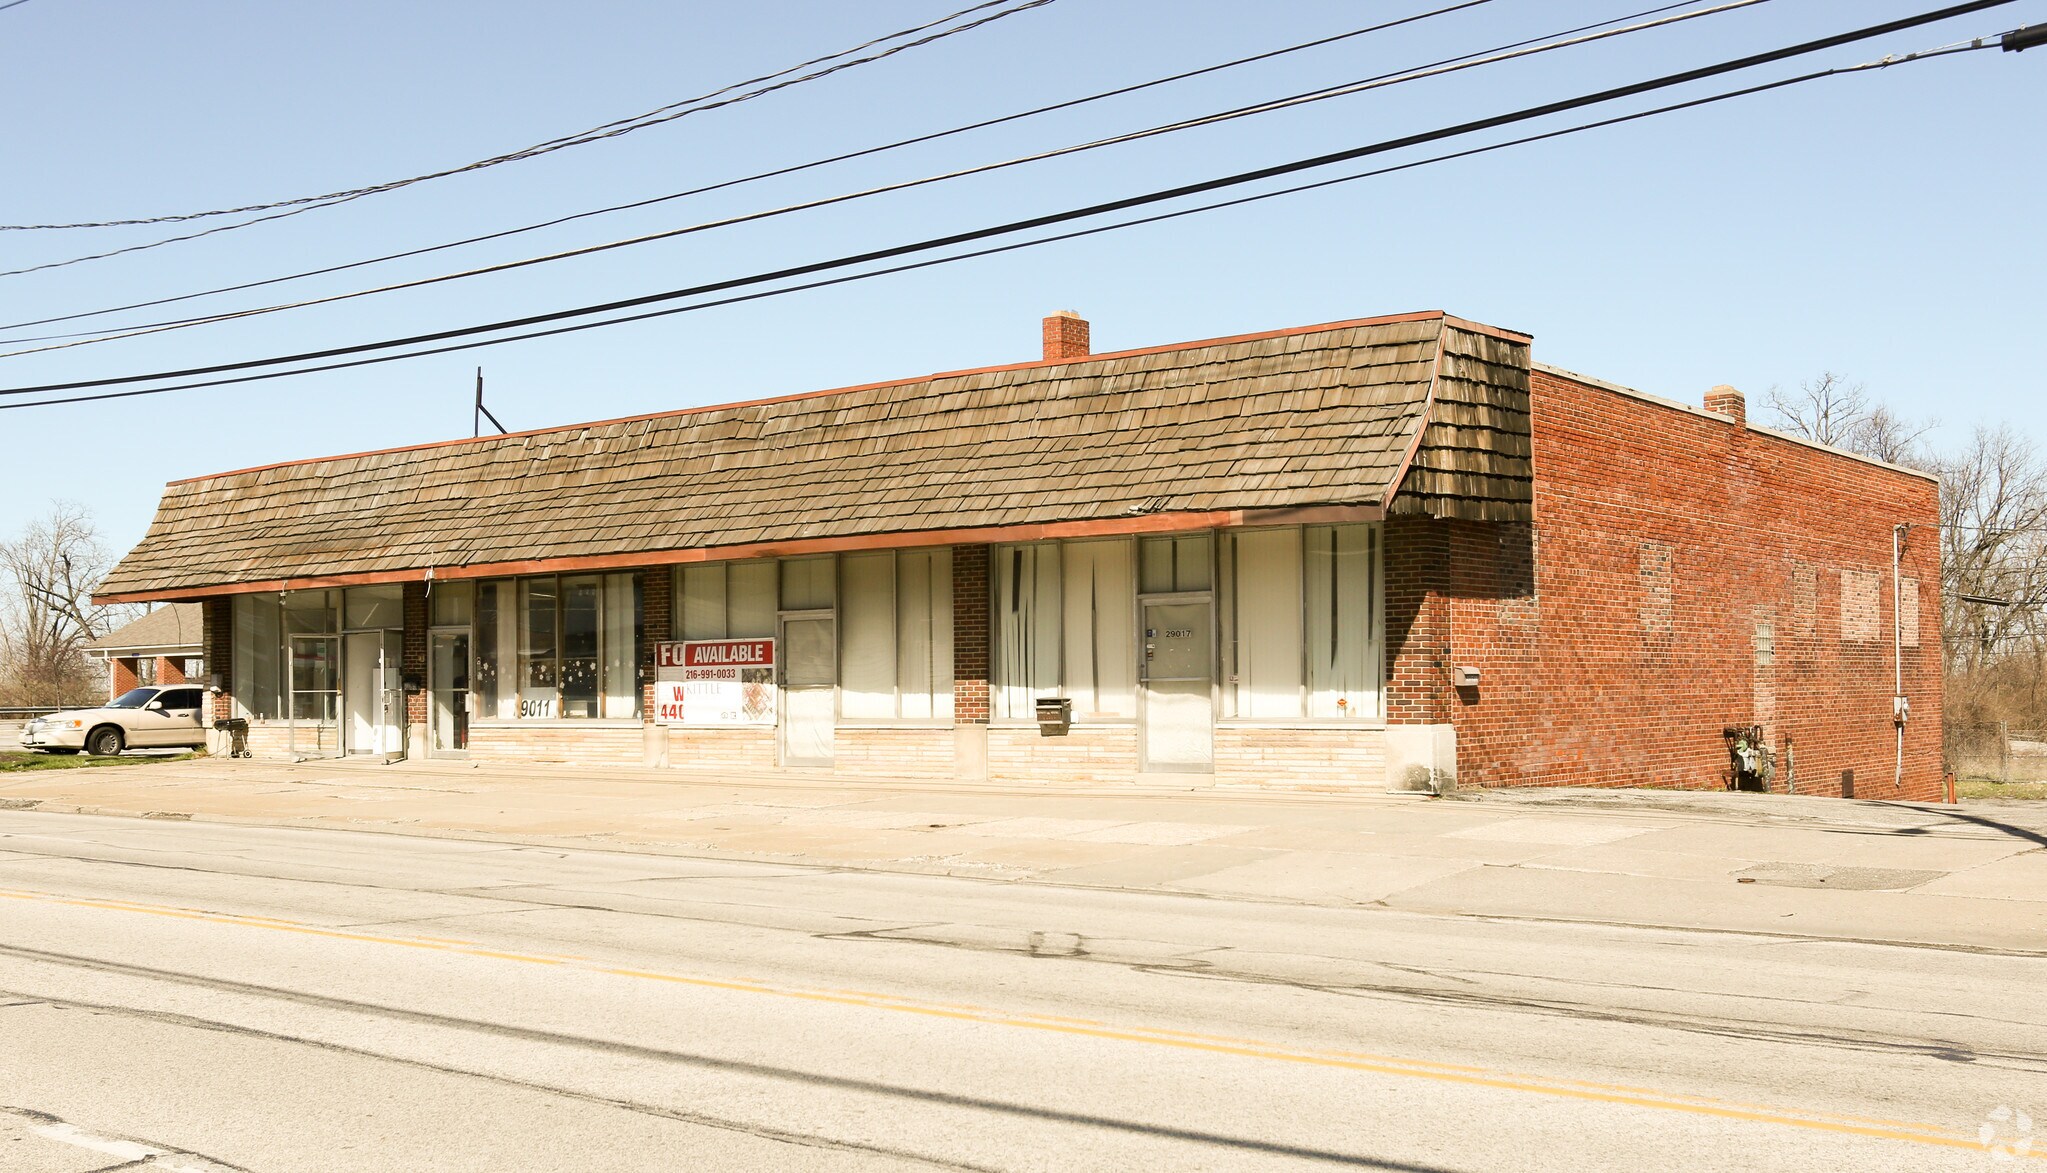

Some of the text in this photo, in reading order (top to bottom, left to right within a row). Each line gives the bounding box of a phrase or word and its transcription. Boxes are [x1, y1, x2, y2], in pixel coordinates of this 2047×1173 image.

[1165, 630, 1191, 638] 29017
[693, 644, 764, 664] AVAILABLE
[685, 668, 736, 680] 216-991-0033
[513, 699, 550, 717] 9011
